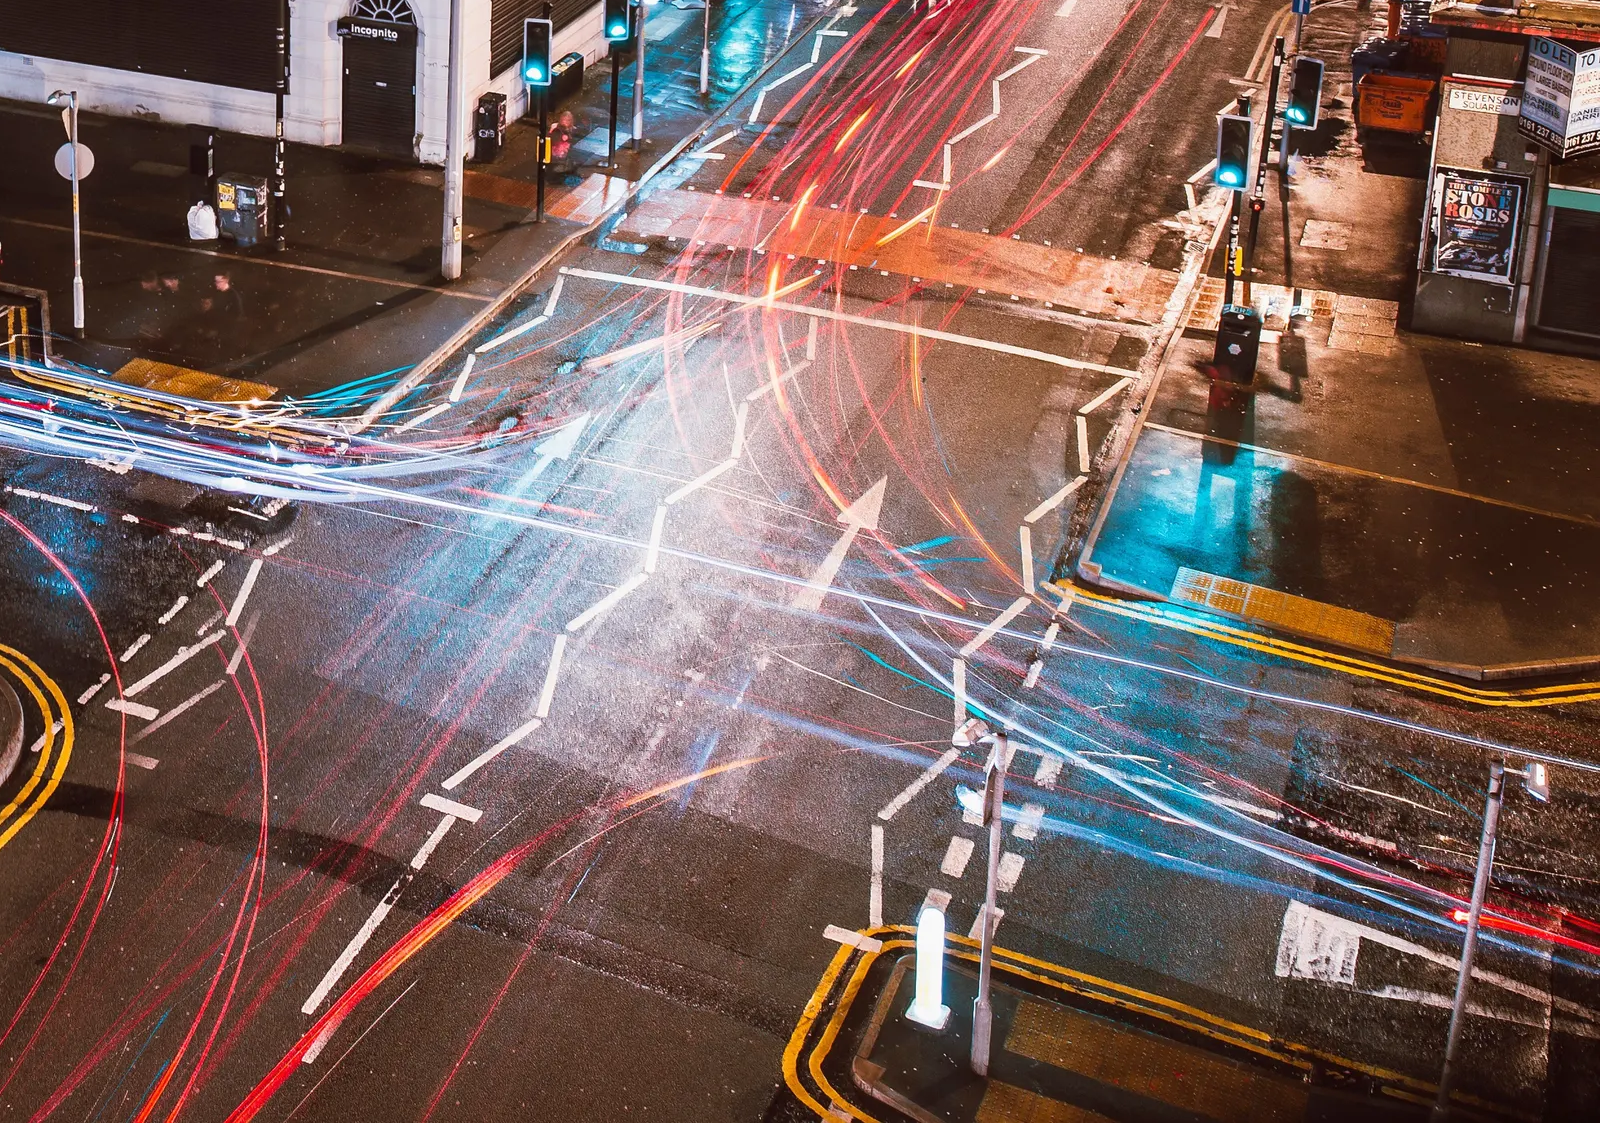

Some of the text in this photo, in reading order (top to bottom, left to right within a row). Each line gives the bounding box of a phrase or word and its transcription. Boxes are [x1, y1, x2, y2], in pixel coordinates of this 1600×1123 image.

[351, 23, 398, 38] incognito
[1533, 37, 1573, 66] TO LET
[1581, 53, 1596, 68] TO
[1546, 63, 1562, 78] FLOOR
[1454, 91, 1519, 107] STEVENSON
[1462, 100, 1501, 113] SQUARE
[1525, 92, 1558, 112] DANIEL
[1524, 98, 1560, 119] HARRIS
[1570, 106, 1600, 120] DANIE
[1519, 117, 1535, 132] 0161
[1537, 126, 1550, 138] 237
[1570, 114, 1600, 125] HARRI
[1565, 136, 1580, 149] 0161
[1581, 131, 1595, 144] 237
[1448, 182, 1466, 190] THE
[1467, 184, 1513, 196] COMPLETE
[1445, 188, 1511, 210] STONE
[1444, 203, 1510, 223] ROSES
